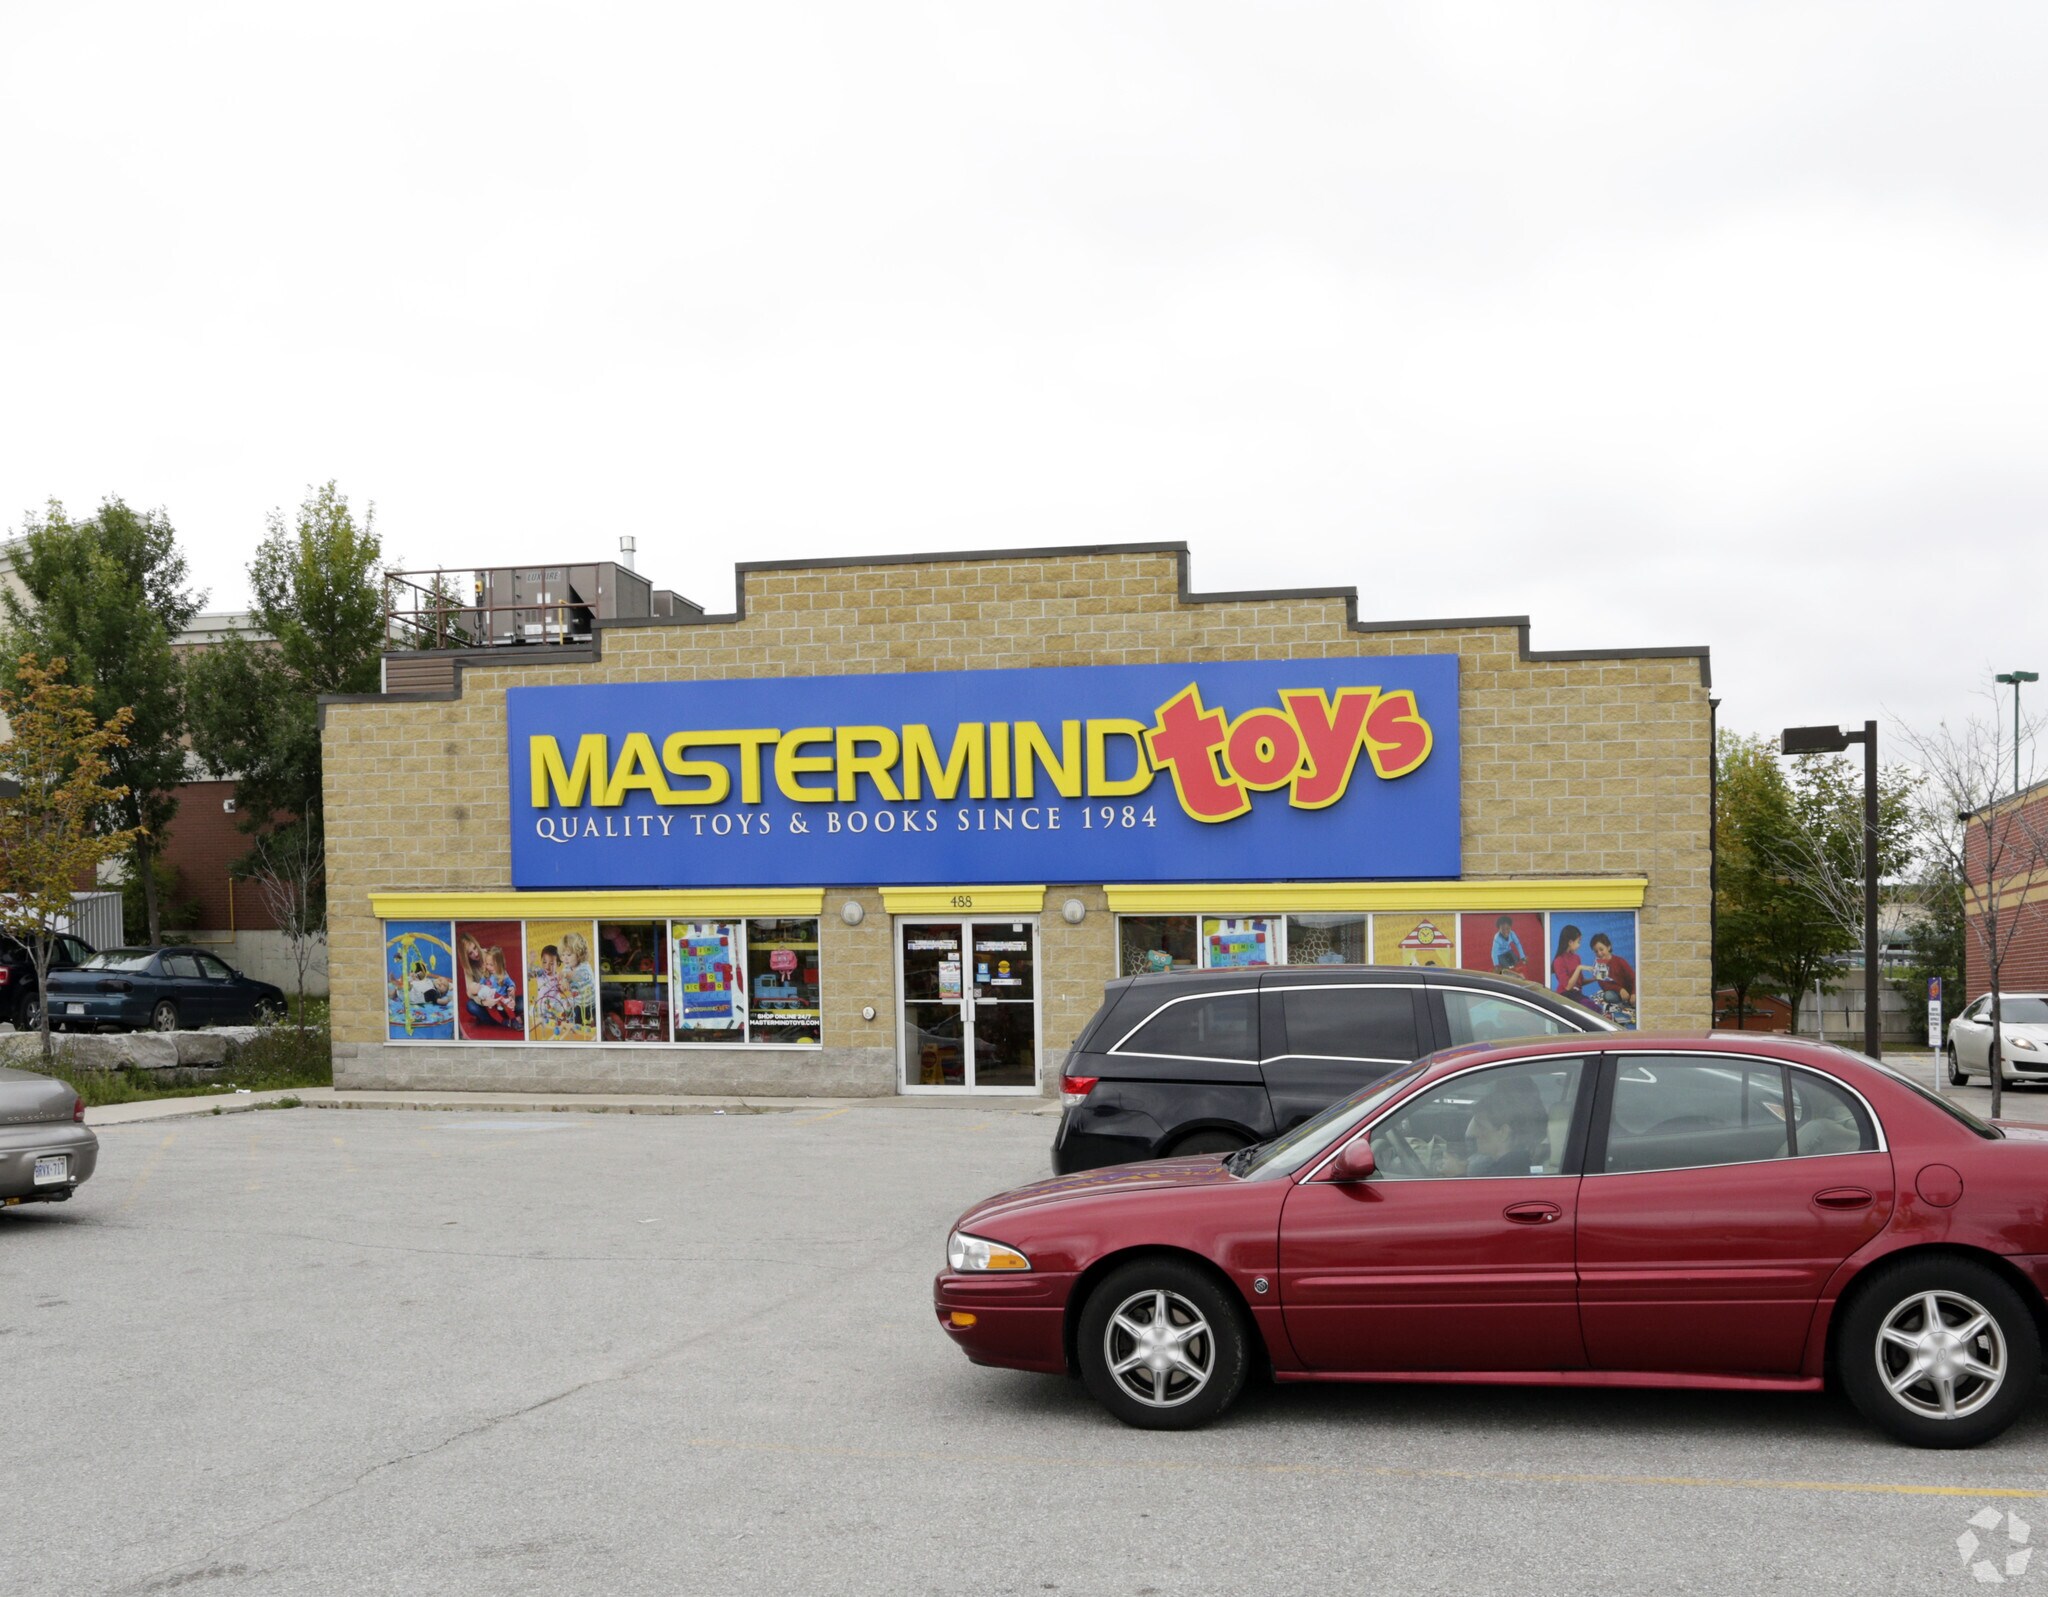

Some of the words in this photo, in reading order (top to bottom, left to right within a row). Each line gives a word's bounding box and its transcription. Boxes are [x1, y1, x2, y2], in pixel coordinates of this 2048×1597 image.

[527, 571, 559, 581] LUXIRE
[530, 718, 1156, 808] MASTERMIND
[1143, 681, 1434, 823] toys
[536, 815, 674, 842] QUALITY
[690, 813, 771, 835] TOYS
[789, 812, 810, 833] &
[827, 809, 938, 833] BOOKS
[958, 807, 1060, 831] SINCE
[1082, 805, 1157, 829] 1984
[950, 895, 972, 908] 488
